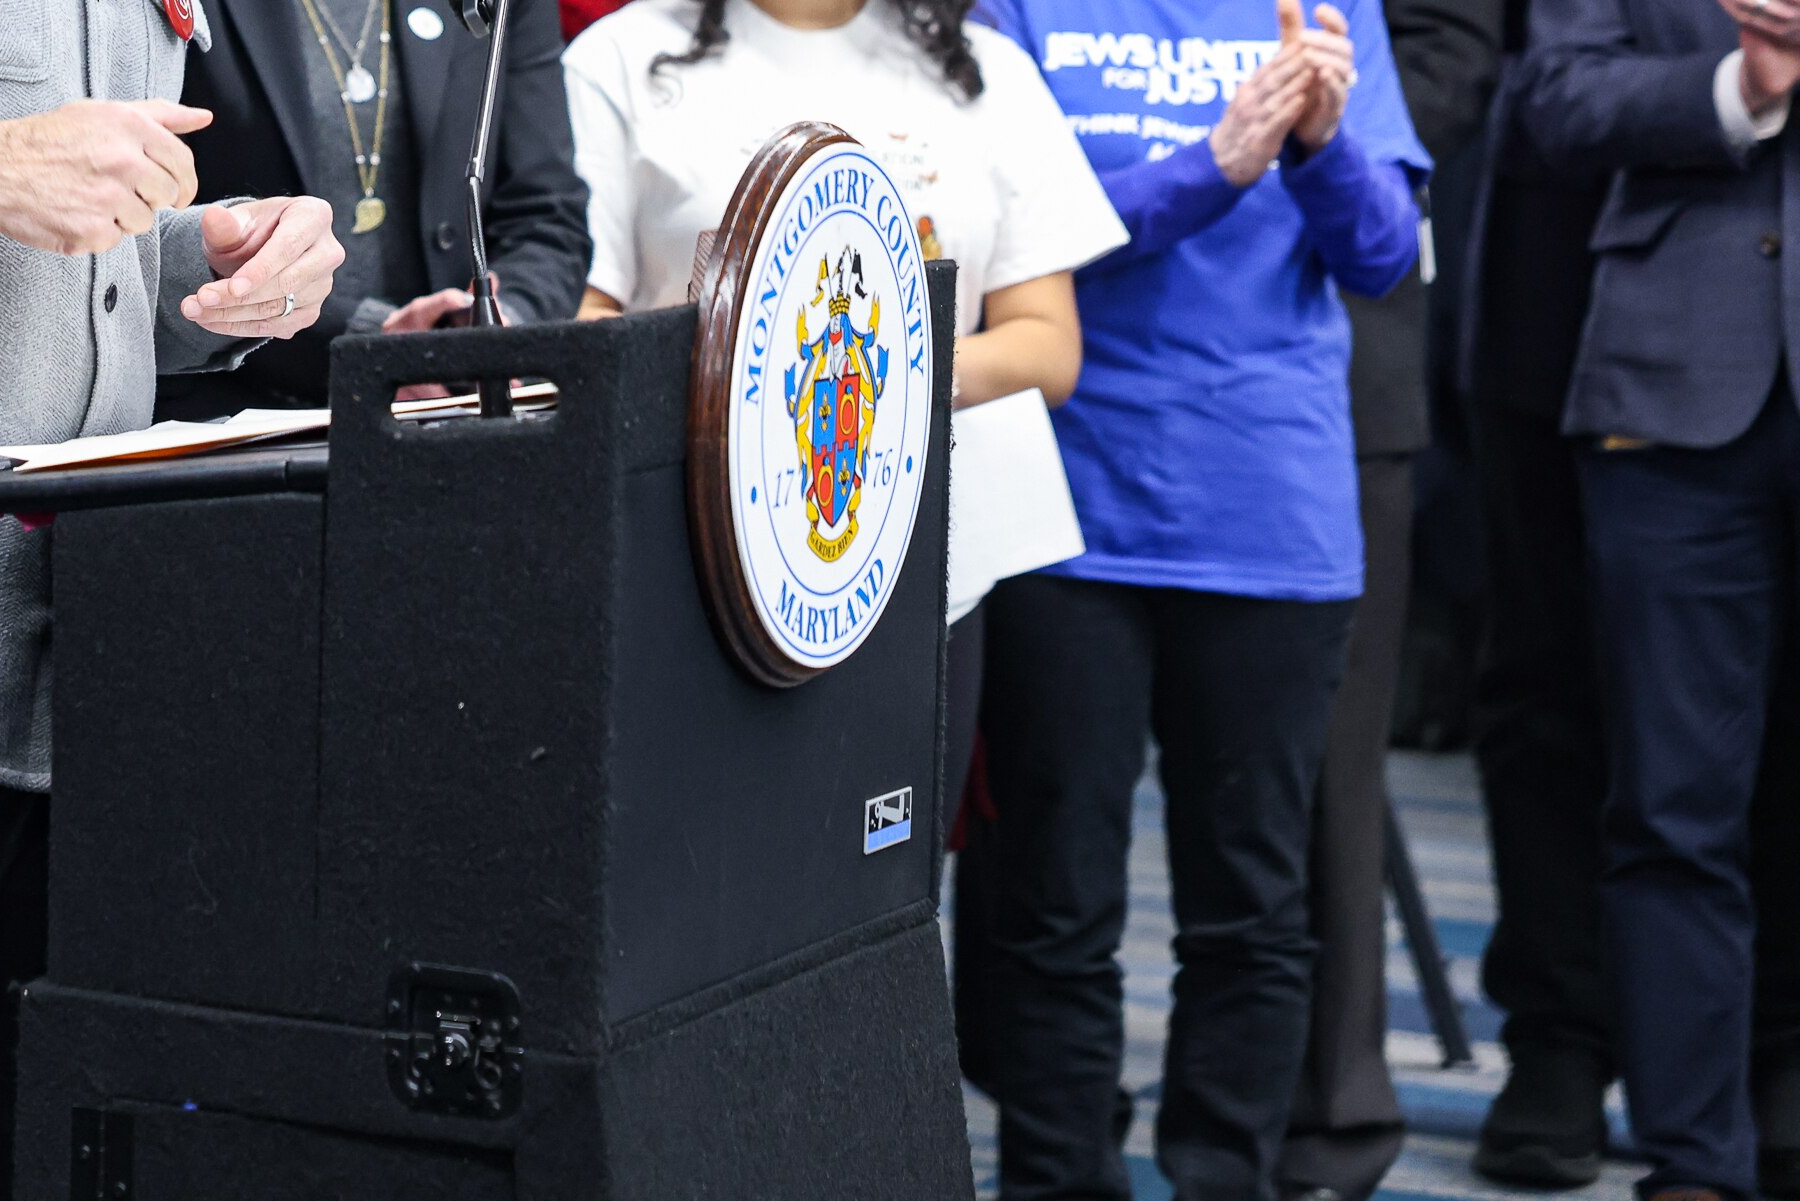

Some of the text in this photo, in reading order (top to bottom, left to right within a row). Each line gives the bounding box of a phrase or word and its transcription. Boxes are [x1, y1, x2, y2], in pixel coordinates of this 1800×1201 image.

[1043, 32, 1283, 74] JEWS UNIT
[1101, 66, 1237, 106] FOR JUST
[745, 169, 925, 406] MONTGOMERY COUNTY
[773, 449, 893, 509] 17 76
[775, 558, 885, 644] MARYLAND
